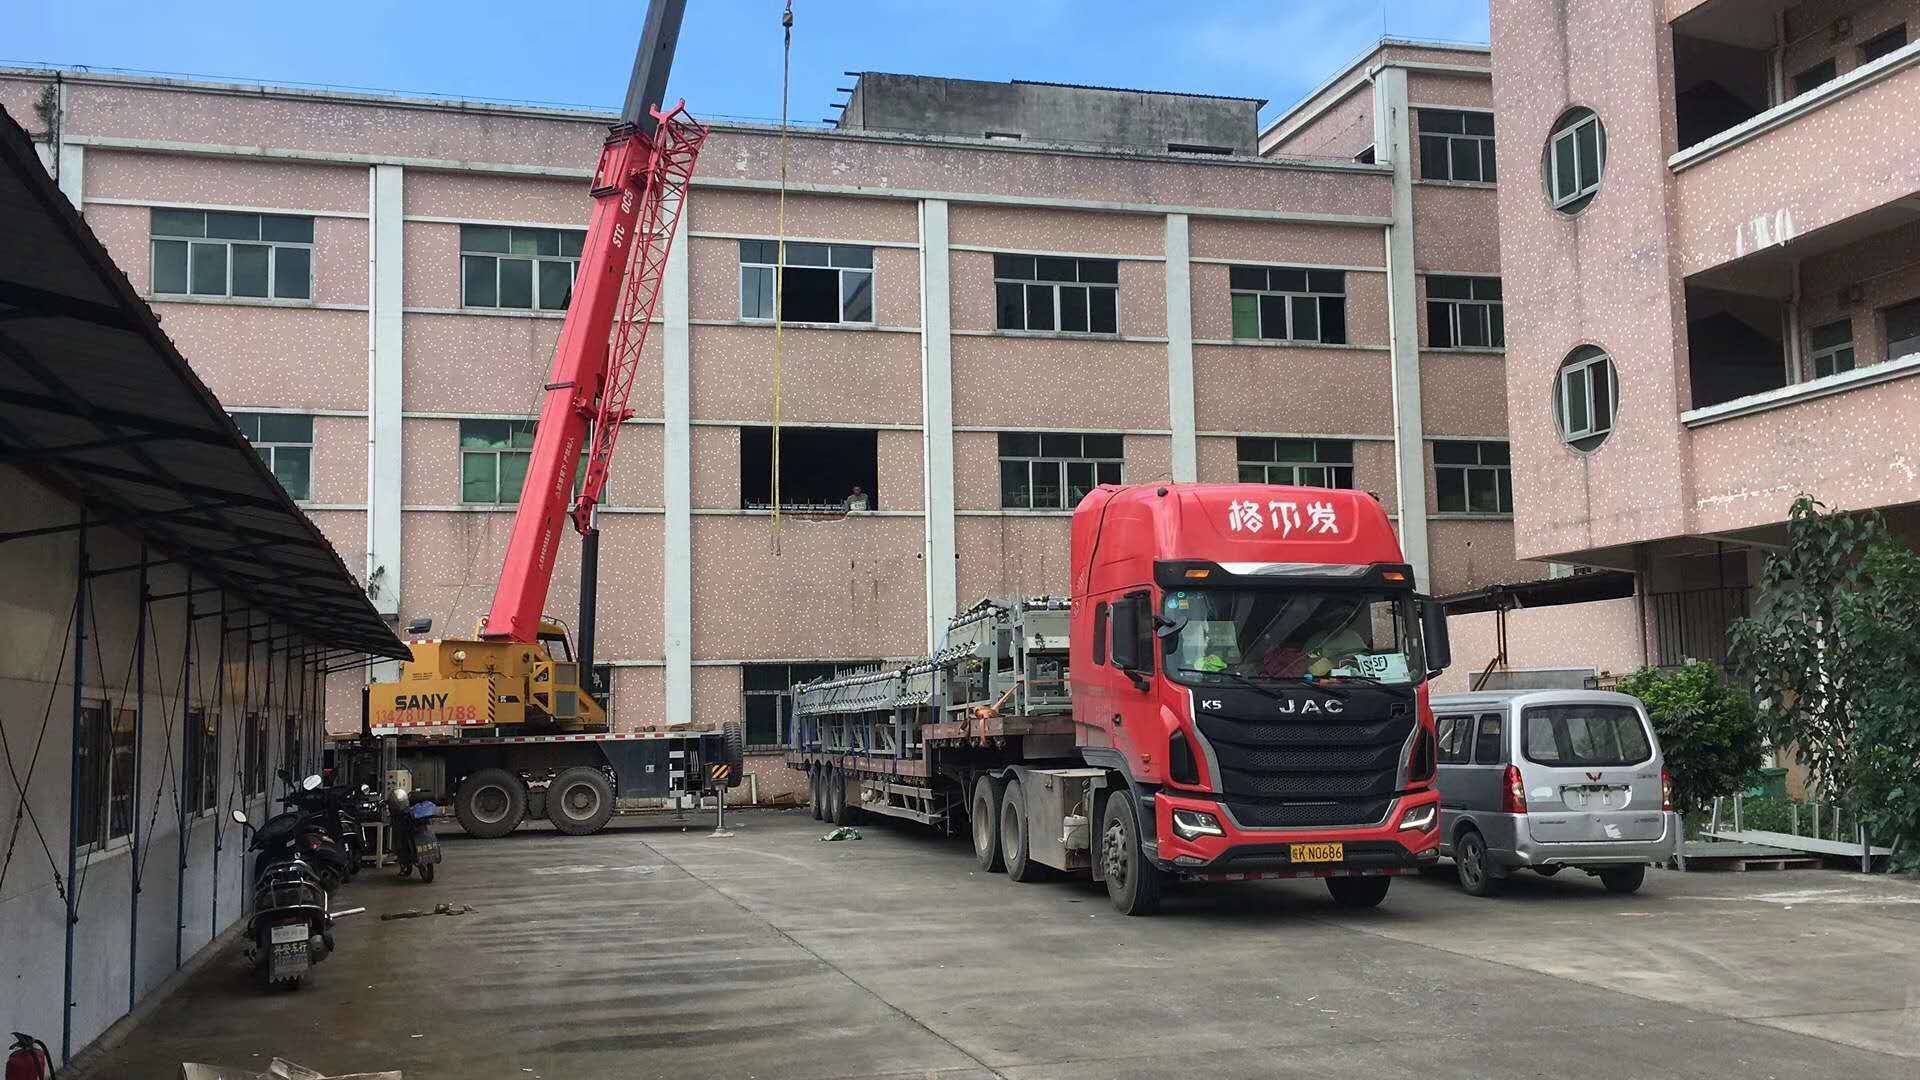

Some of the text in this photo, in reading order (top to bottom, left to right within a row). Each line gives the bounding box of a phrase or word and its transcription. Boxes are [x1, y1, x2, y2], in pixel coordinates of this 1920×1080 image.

[612, 223, 625, 248] STC
[1228, 499, 1339, 539] 格尔发
[395, 693, 449, 711] SANY
[1202, 700, 1222, 710] K5
[1279, 699, 1344, 715] JAC
